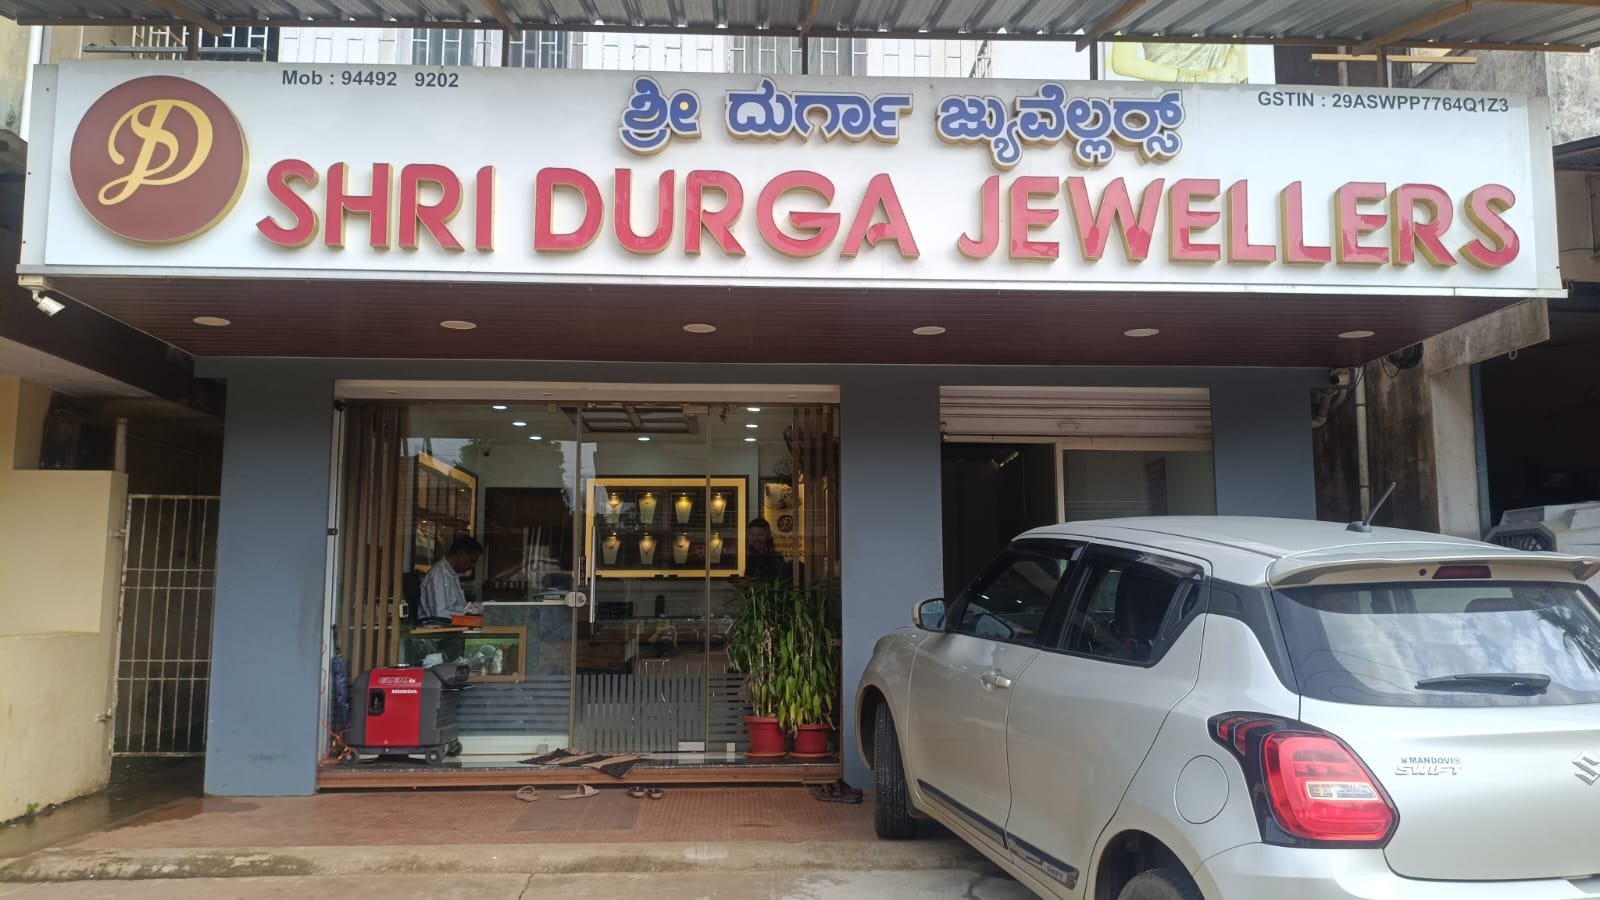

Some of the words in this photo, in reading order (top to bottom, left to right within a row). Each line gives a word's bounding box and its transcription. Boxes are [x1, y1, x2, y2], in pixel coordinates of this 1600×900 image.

[282, 70, 322, 85] Mob
[341, 71, 397, 86] 94492
[414, 72, 459, 88] 9202
[1257, 91, 1314, 107] GSTIN
[1332, 93, 1509, 113] 29ASWPP7764Q1Z3
[619, 76, 701, 155] ಶ್ರೀ
[726, 77, 913, 142] ದುರ್ಗಾ
[256, 159, 495, 252] SHRI
[535, 167, 920, 259] DURGA
[957, 174, 1520, 270] JEWELLERS
[1394, 764, 1460, 776] SWIFT
[1409, 756, 1454, 764] MANDOVI
